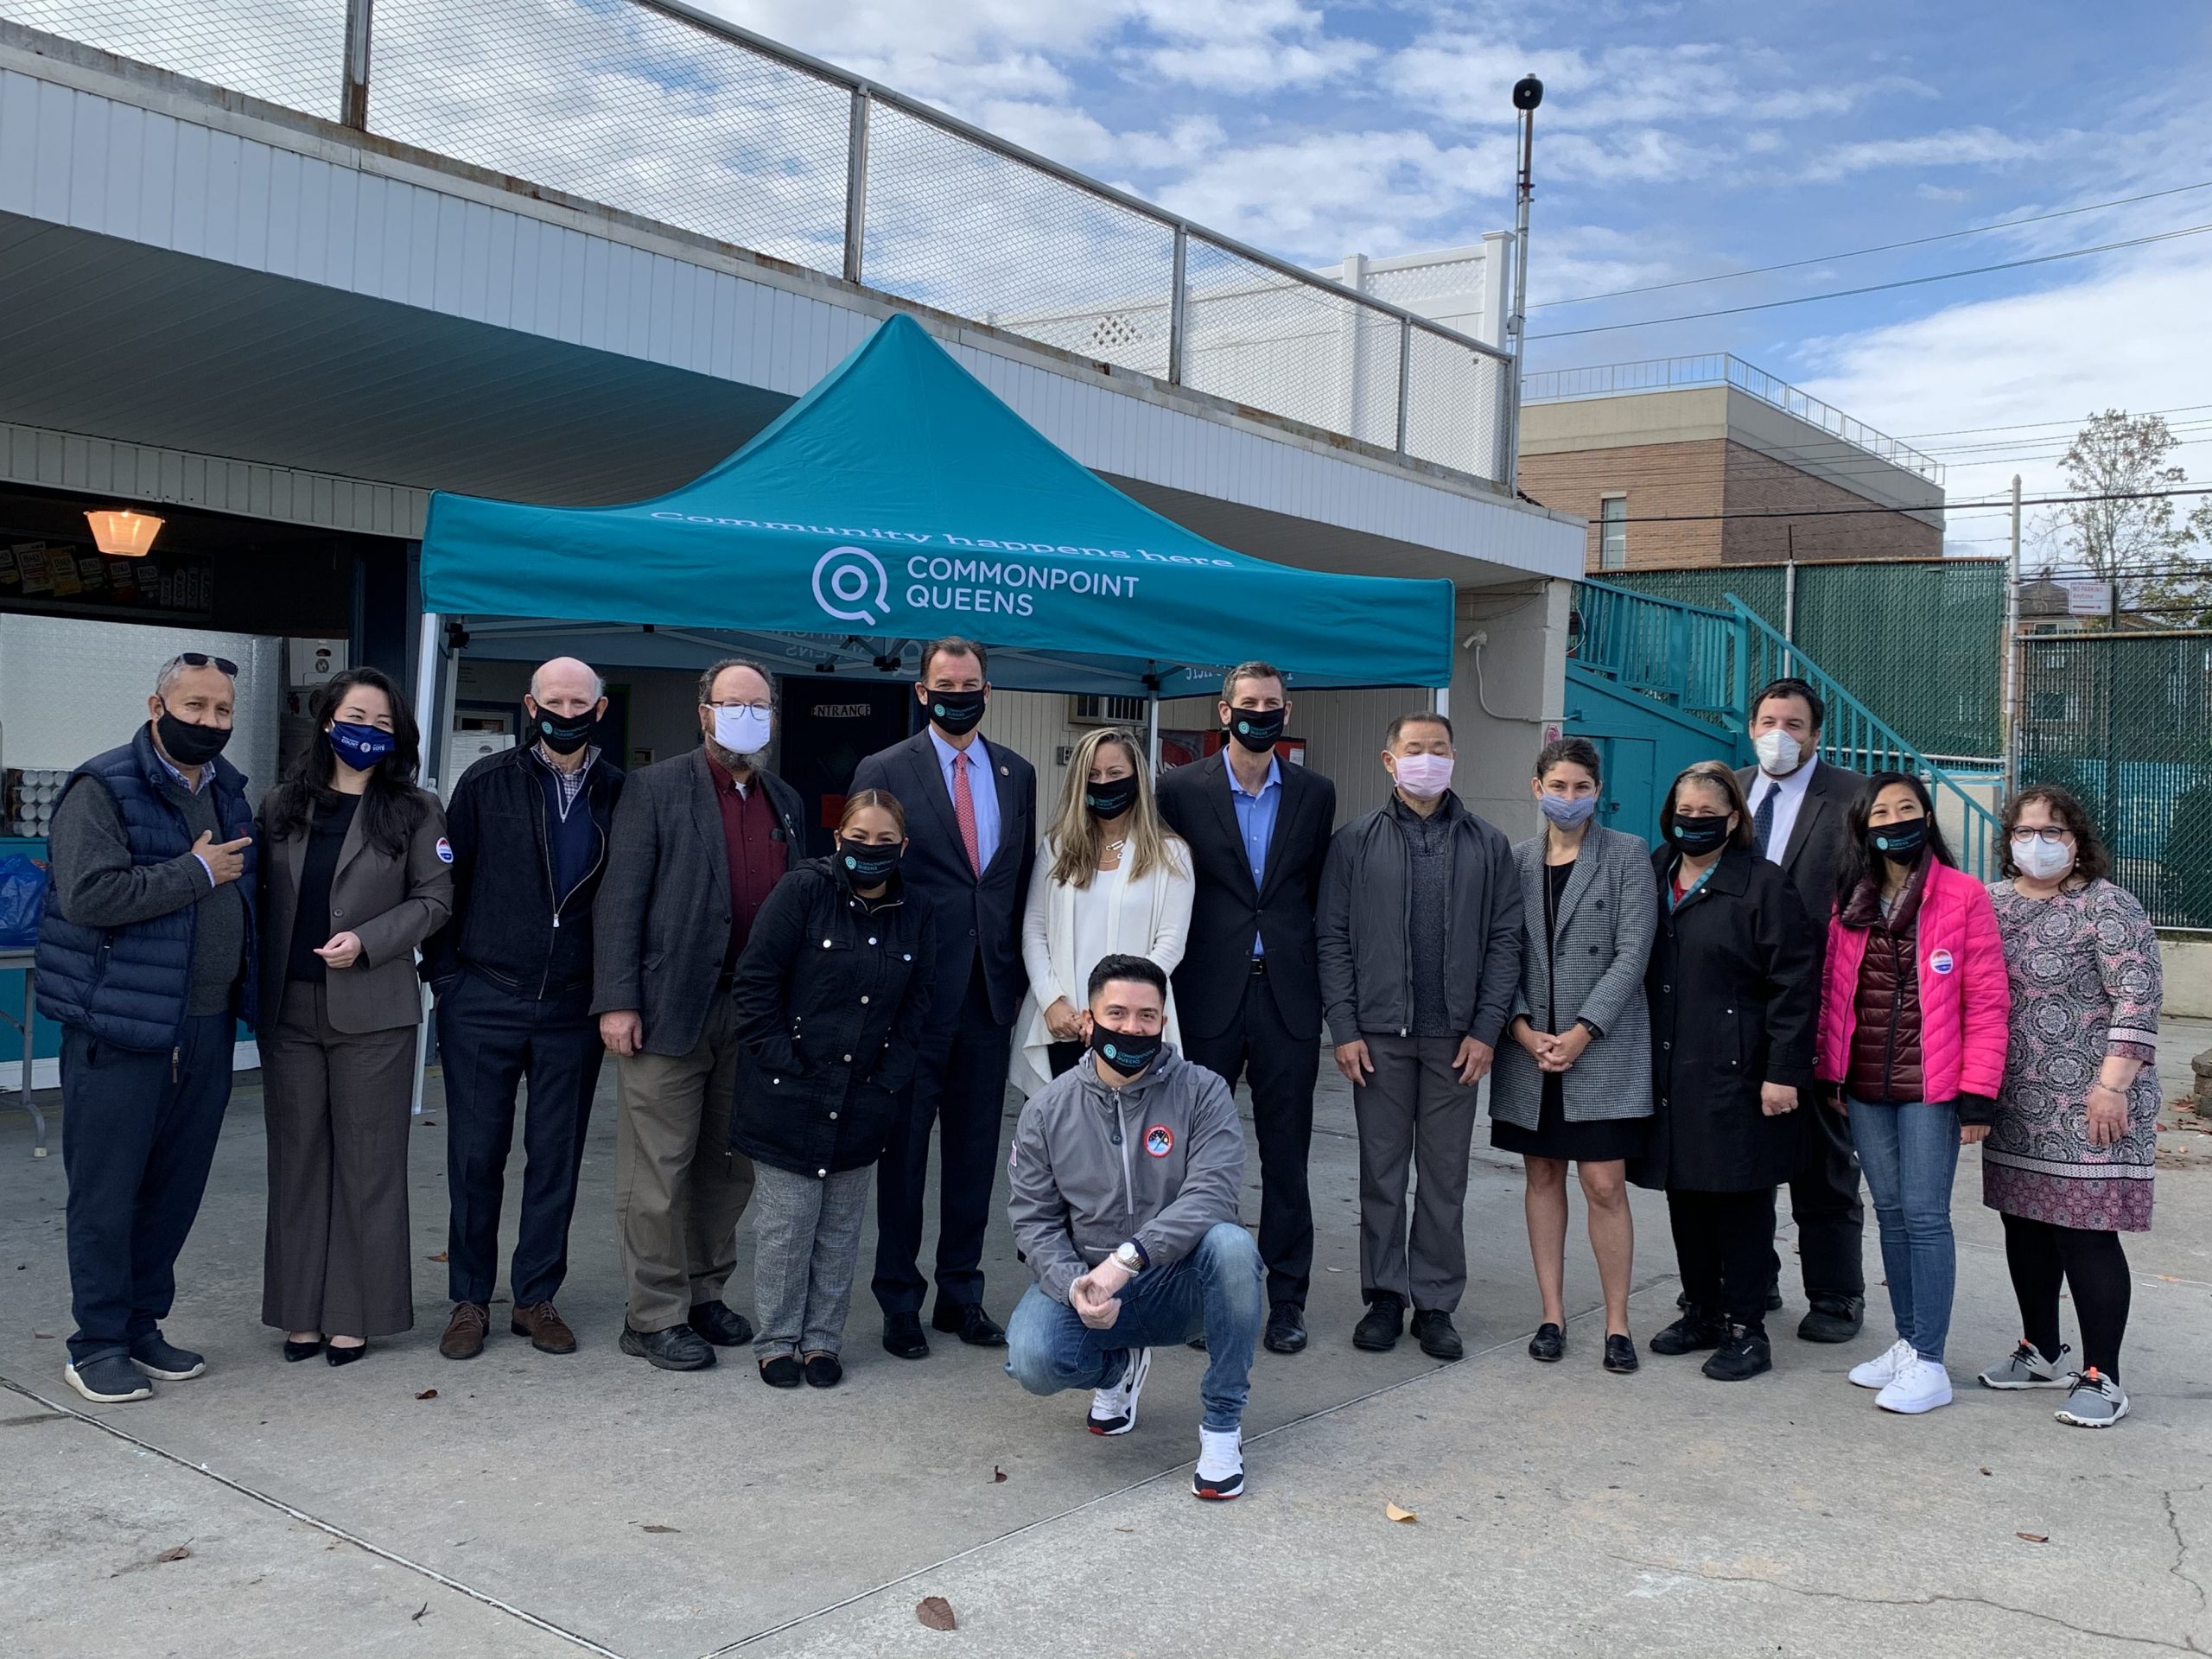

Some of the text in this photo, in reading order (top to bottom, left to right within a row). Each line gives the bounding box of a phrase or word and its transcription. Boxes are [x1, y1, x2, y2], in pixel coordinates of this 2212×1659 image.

[651, 512, 1236, 568] Community happens here
[907, 556, 1140, 598] COMMONPOINT
[906, 584, 1033, 616] QUEENS
[811, 704, 872, 717] ENTRANCE
